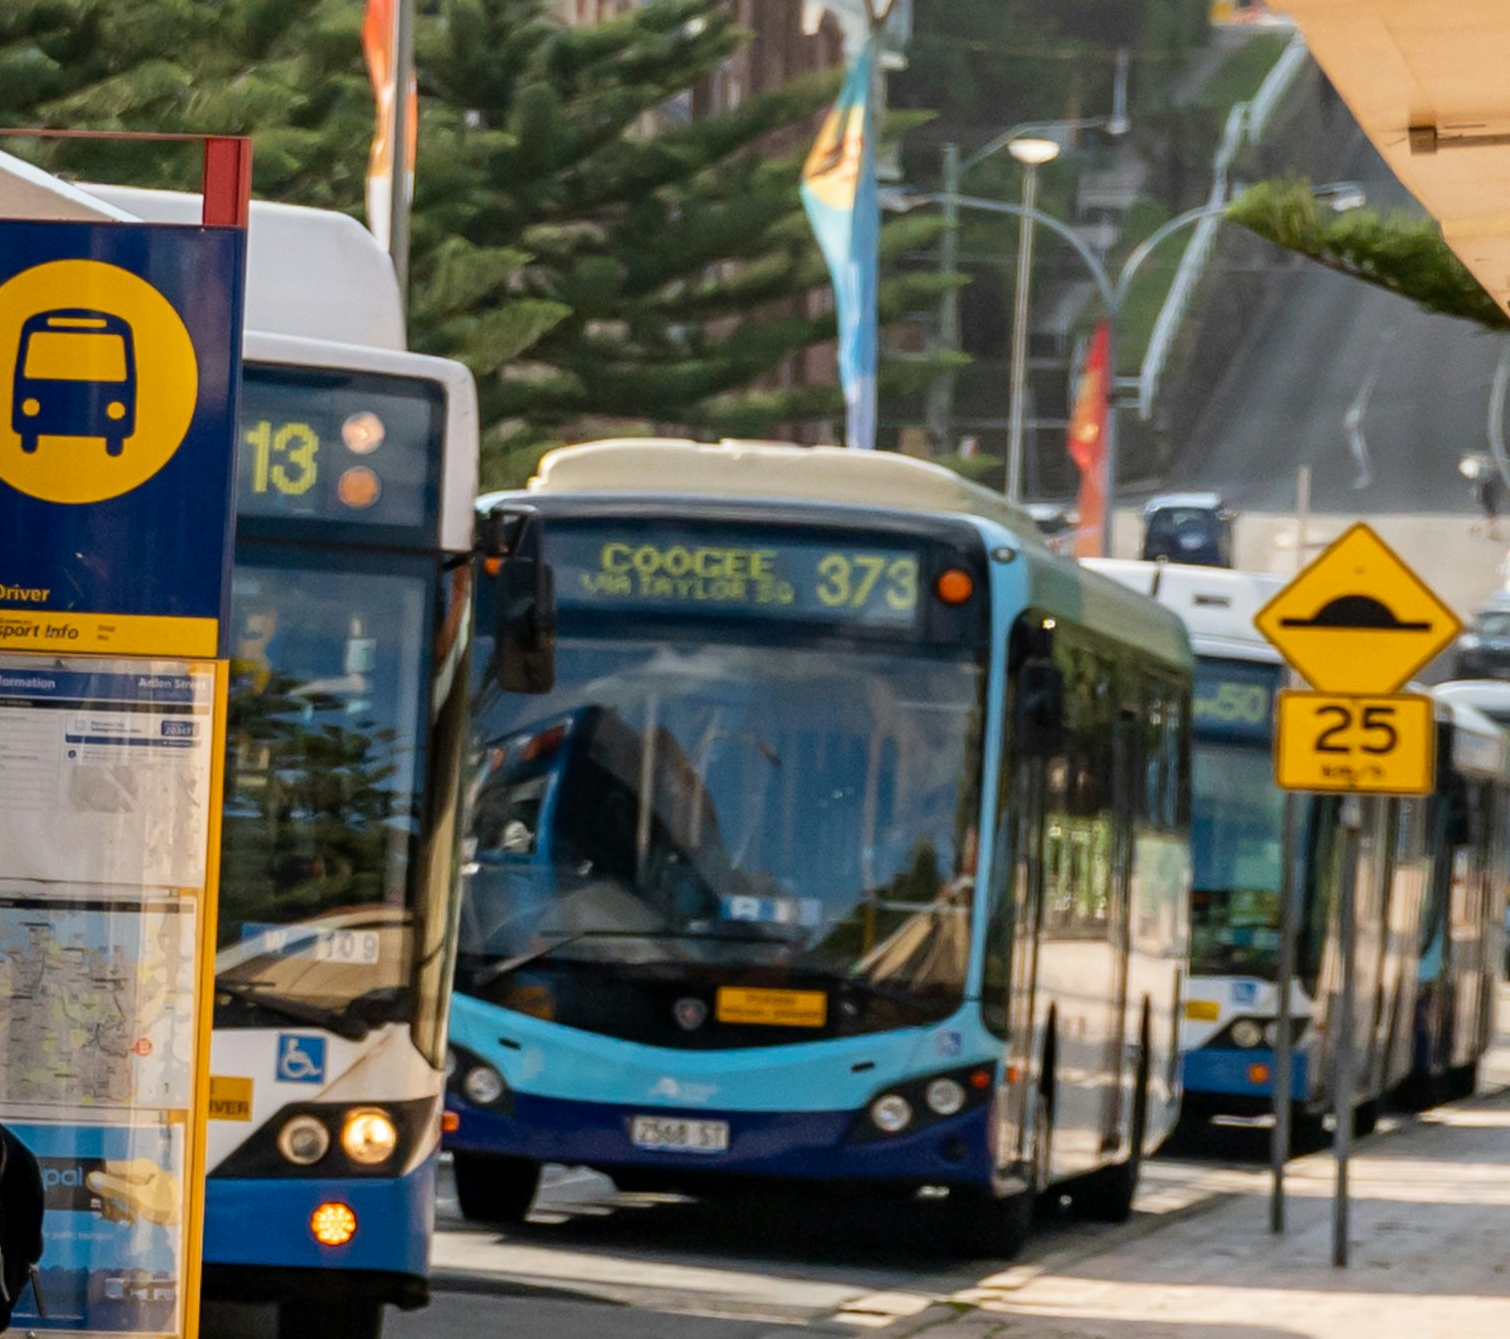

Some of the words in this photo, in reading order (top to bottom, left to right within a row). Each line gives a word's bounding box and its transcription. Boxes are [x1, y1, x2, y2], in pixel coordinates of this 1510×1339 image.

[600, 541, 778, 580] COOGEE
[816, 552, 918, 611] 373
[45, 624, 79, 641] Info
[1314, 705, 1399, 755] 25
[208, 1099, 250, 1116] IVER
[43, 1166, 84, 1188] pal
